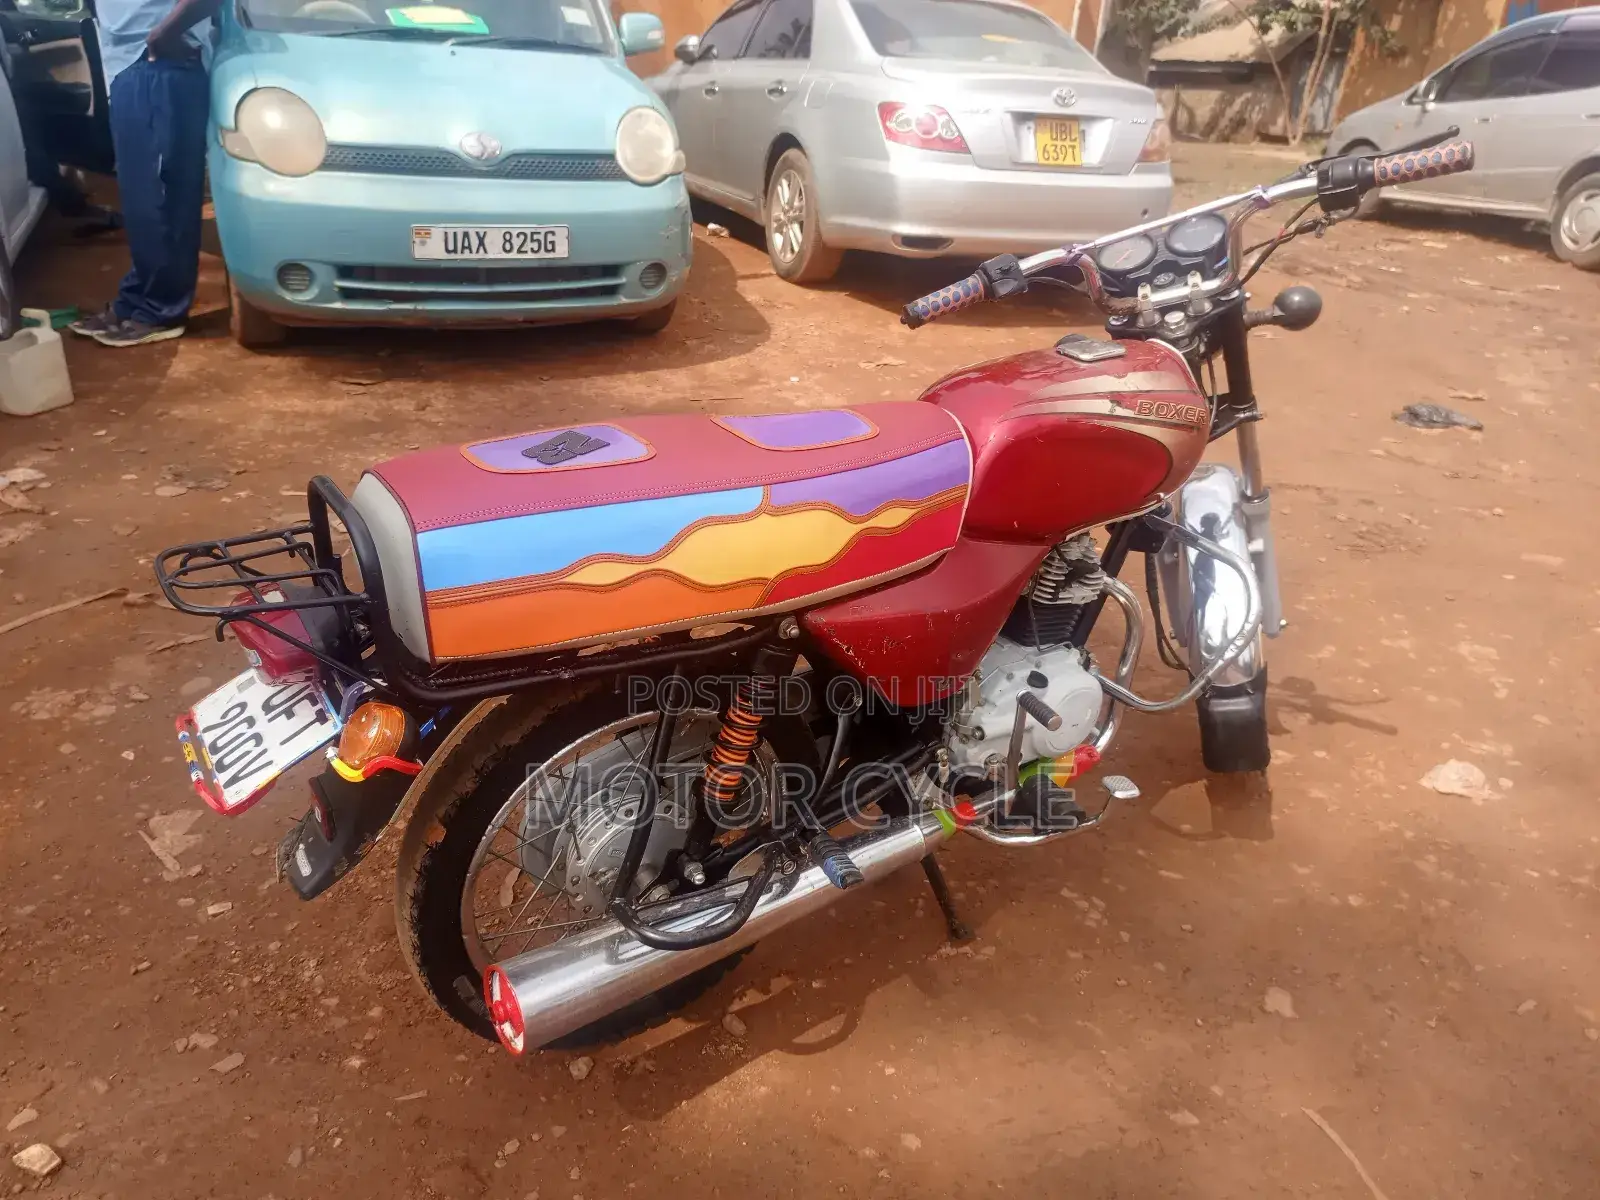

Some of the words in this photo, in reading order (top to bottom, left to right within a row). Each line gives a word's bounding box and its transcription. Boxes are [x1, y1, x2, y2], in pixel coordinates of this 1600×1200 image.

[1049, 122, 1078, 142] UBL
[1042, 143, 1077, 162] 639T
[444, 231, 488, 254] UAX
[501, 230, 556, 254] 825G
[1134, 400, 1207, 425] BOXER
